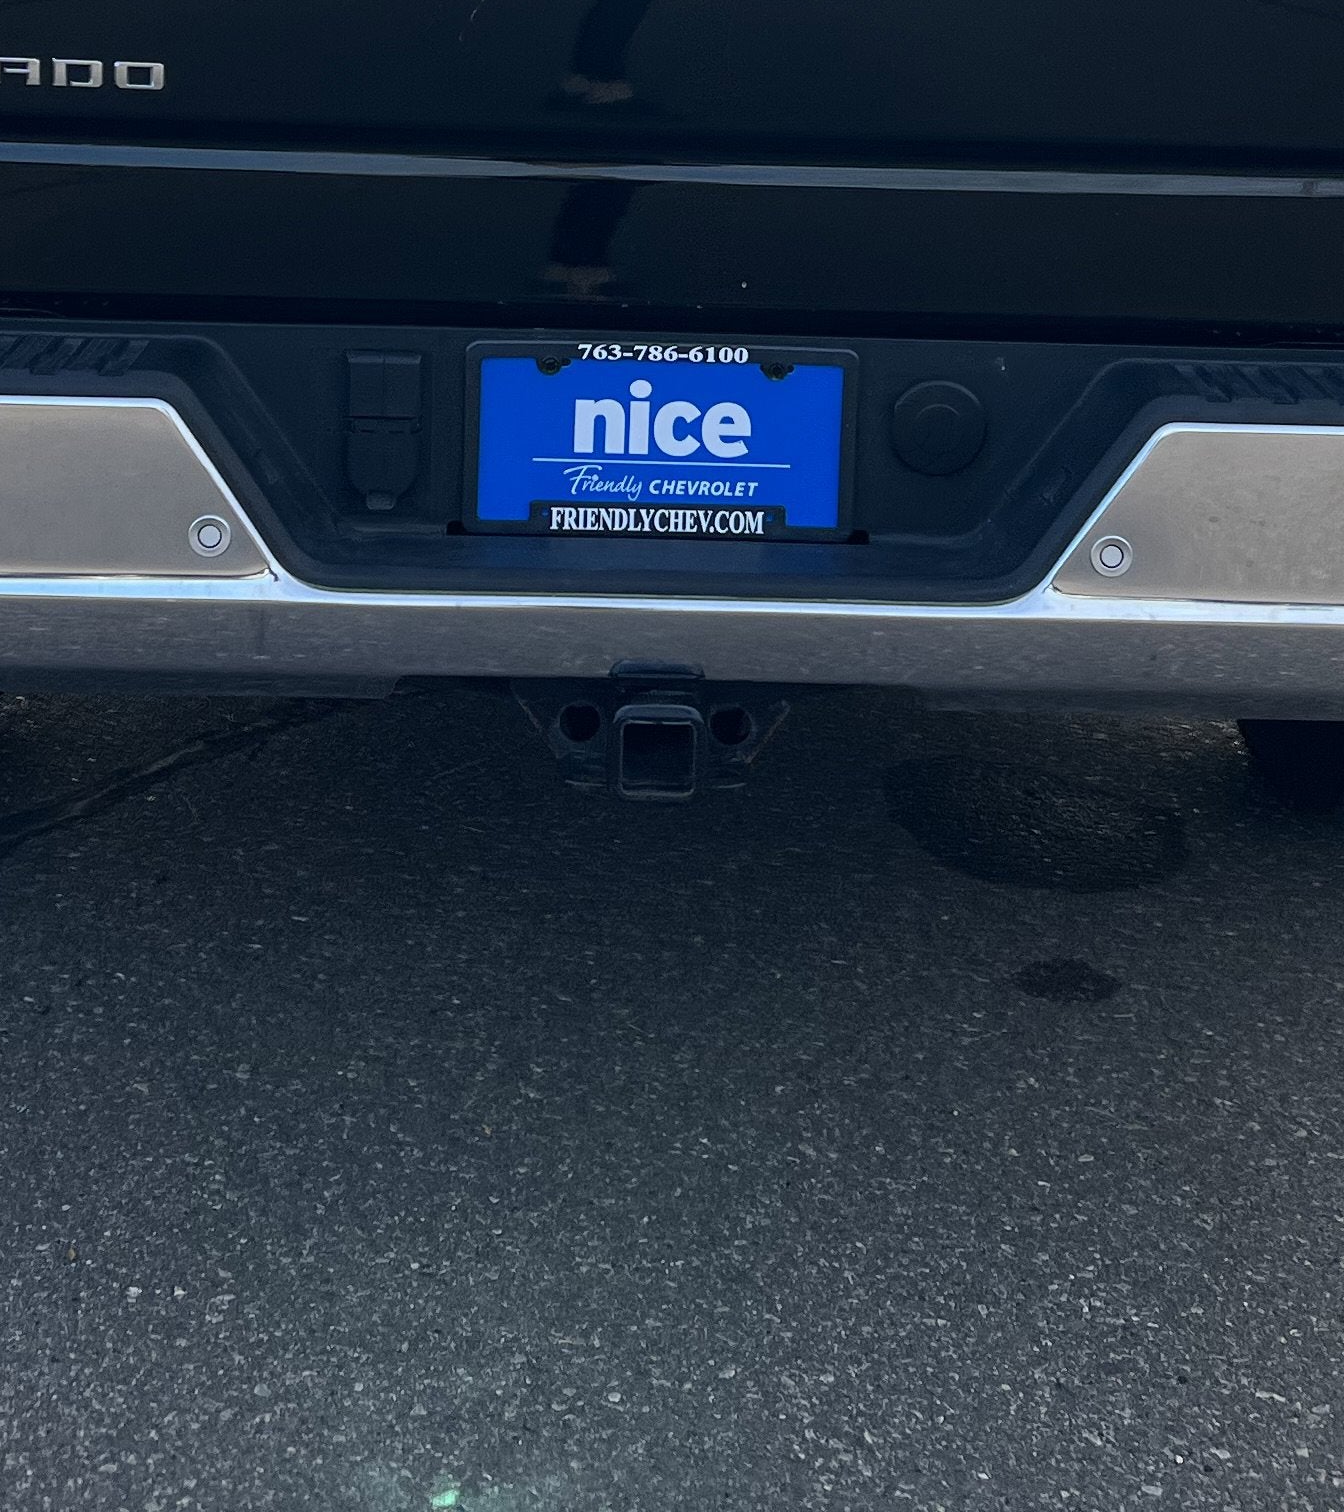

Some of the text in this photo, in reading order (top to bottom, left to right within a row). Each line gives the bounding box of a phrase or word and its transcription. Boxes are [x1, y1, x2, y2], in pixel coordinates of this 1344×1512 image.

[577, 344, 749, 364] 763-786-6100
[573, 379, 752, 458] nice
[563, 464, 759, 501] Friendly CHEVROLET
[549, 506, 765, 535] FRIENDLYCHEV.COM
